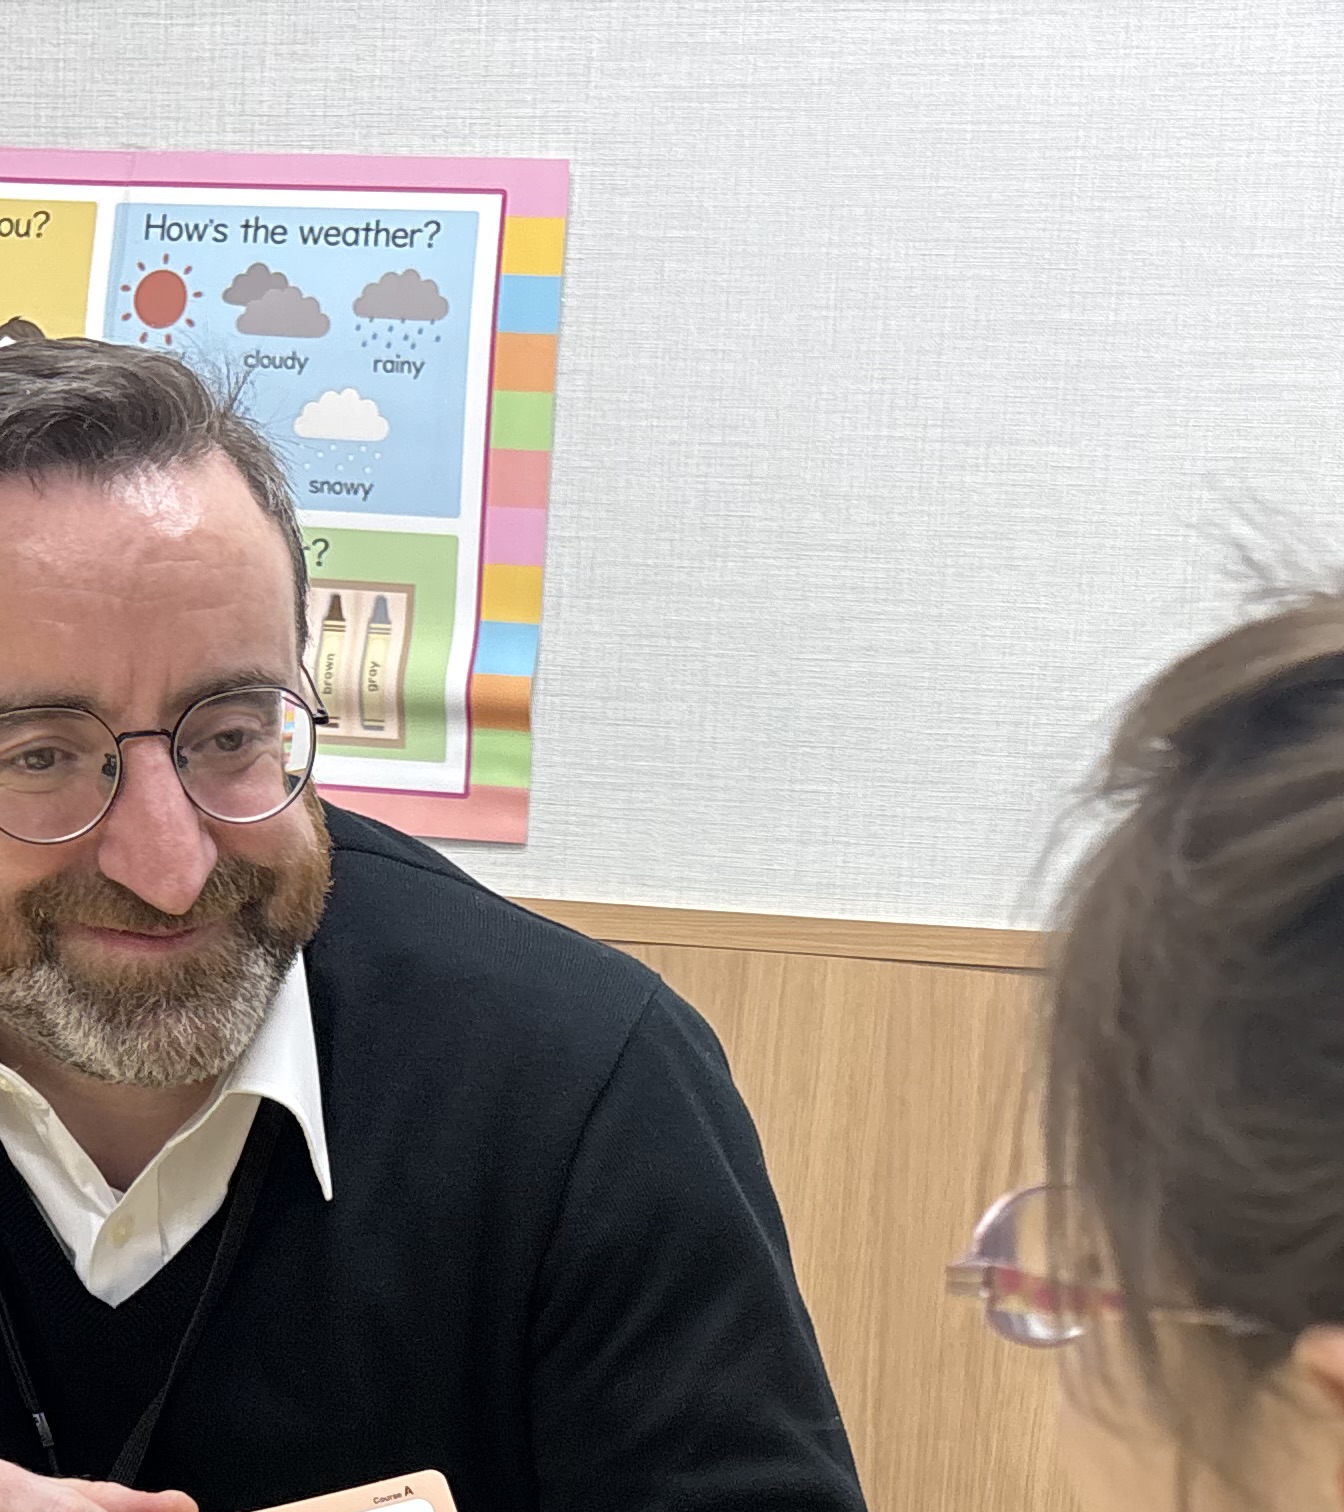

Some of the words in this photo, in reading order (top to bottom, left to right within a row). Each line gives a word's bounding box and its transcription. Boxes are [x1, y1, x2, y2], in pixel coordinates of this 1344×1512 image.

[144, 213, 229, 244] How's
[240, 215, 288, 245] the
[299, 219, 442, 249] weather?
[243, 350, 310, 376] cloudy
[372, 354, 426, 380] rainy
[308, 478, 375, 502] snowy
[322, 652, 337, 695] brown
[366, 660, 384, 693] gray
[404, 1485, 415, 1497] A
